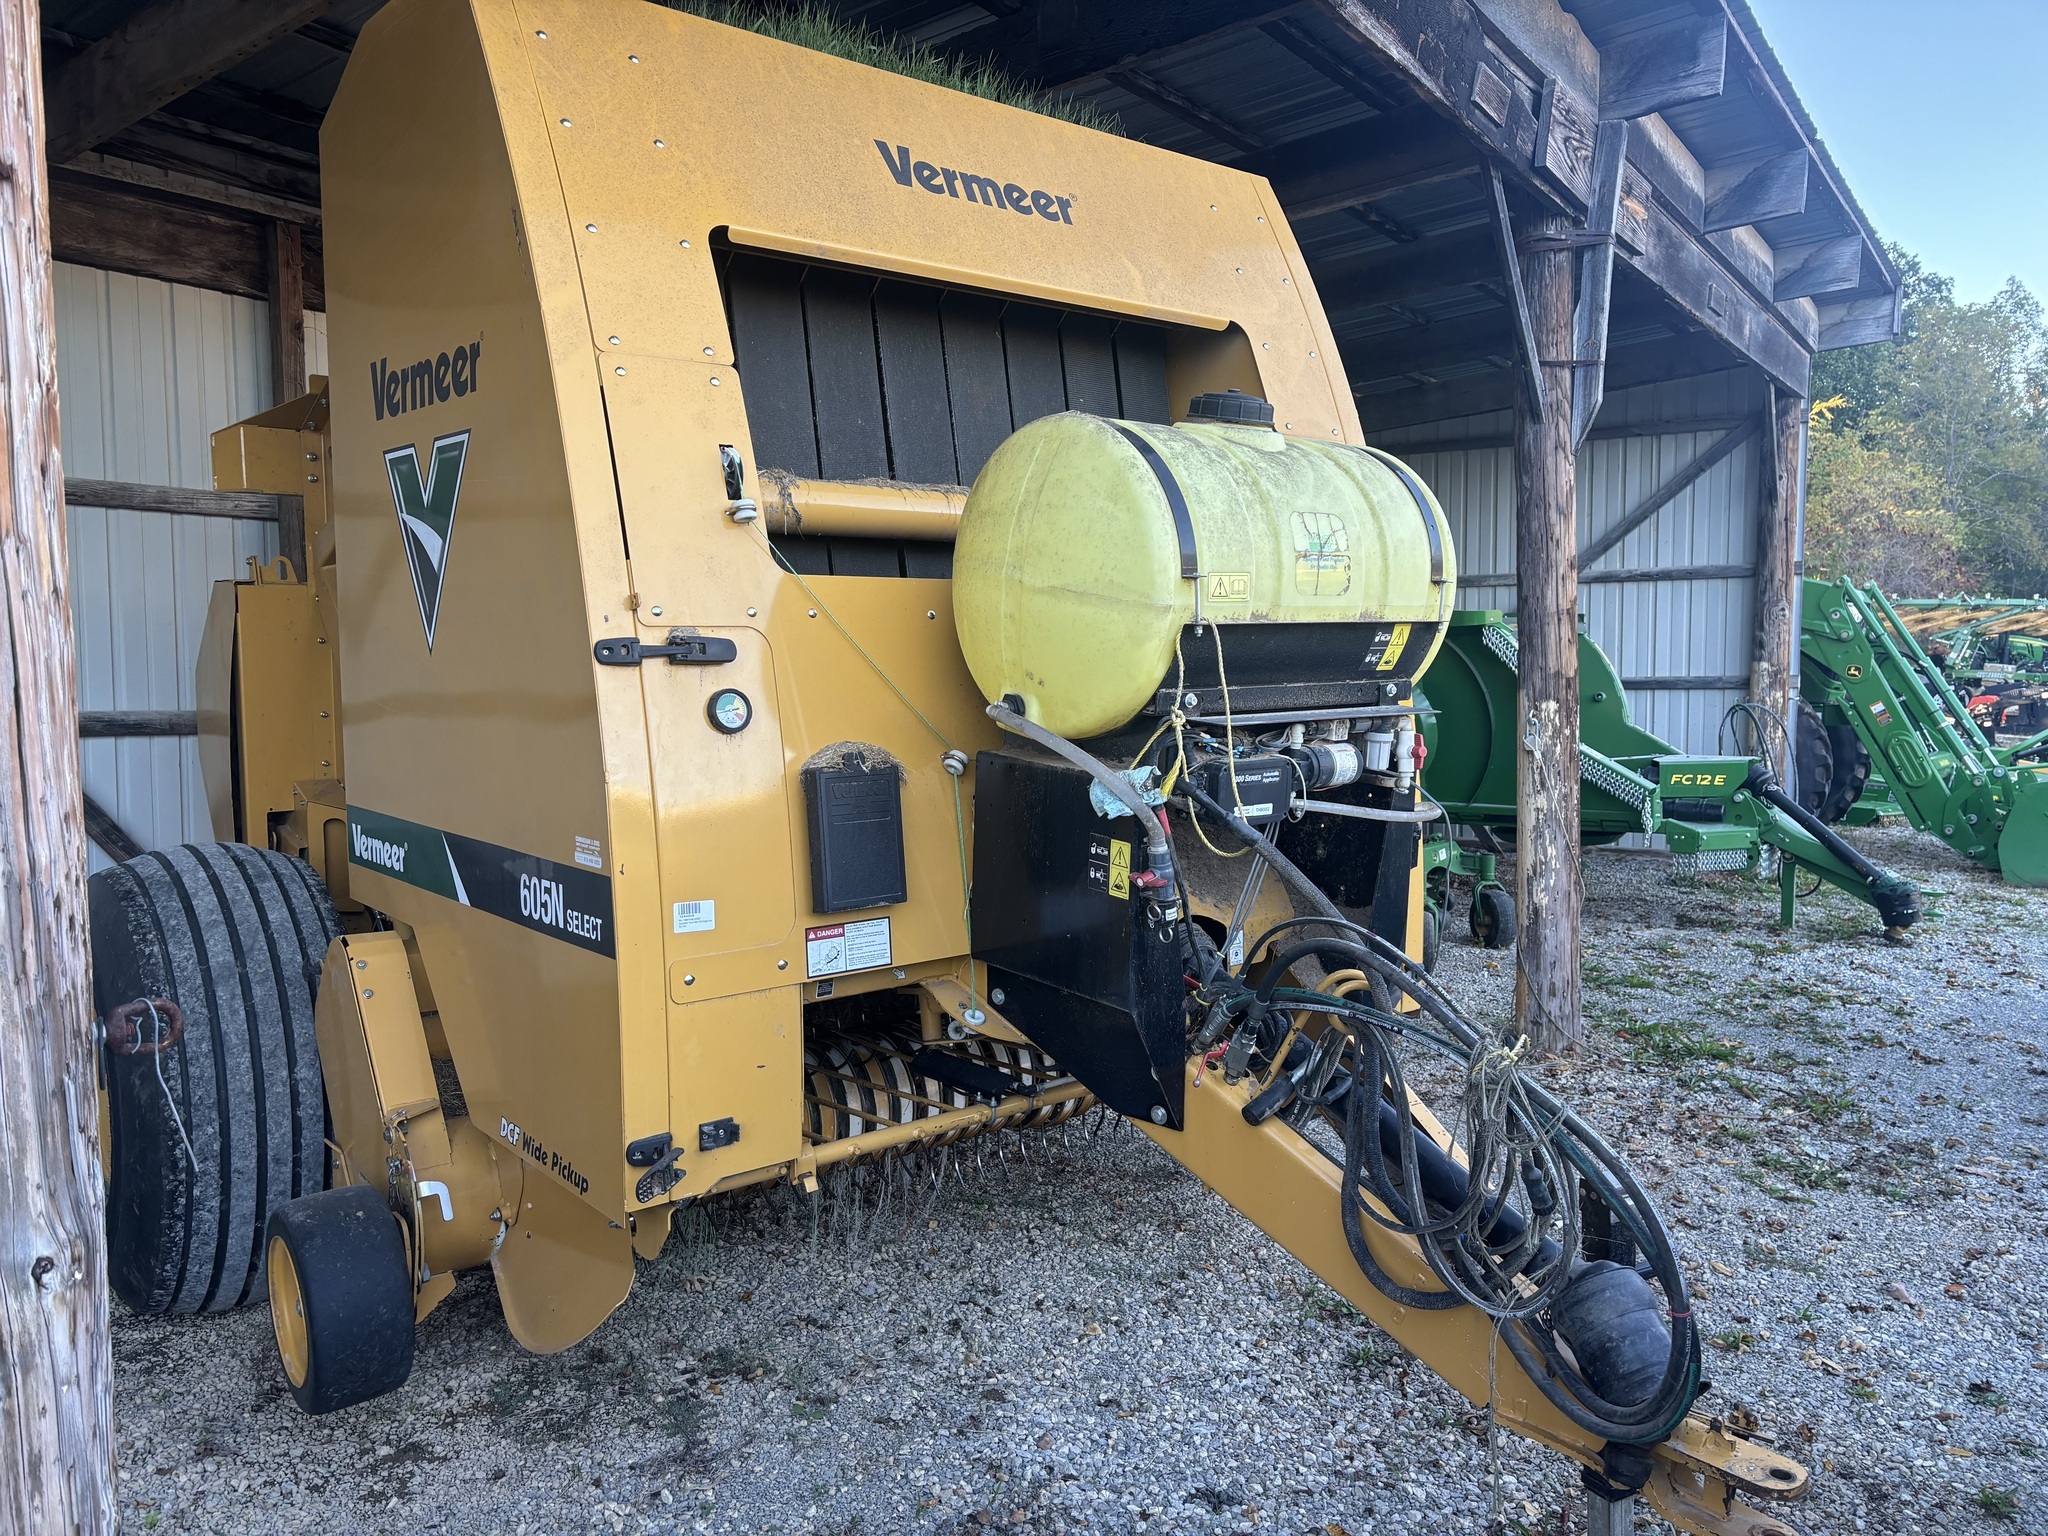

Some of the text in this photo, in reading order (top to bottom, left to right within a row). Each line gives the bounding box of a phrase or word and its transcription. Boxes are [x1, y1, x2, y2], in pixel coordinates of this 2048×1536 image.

[873, 139, 1073, 225] Vermeer
[370, 341, 480, 421] Vermeer
[351, 823, 405, 873] Vermeer
[519, 873, 602, 942] 605N SELECT
[816, 927, 844, 938] DANGER
[500, 1116, 589, 1195] DCF Wide Pickup
